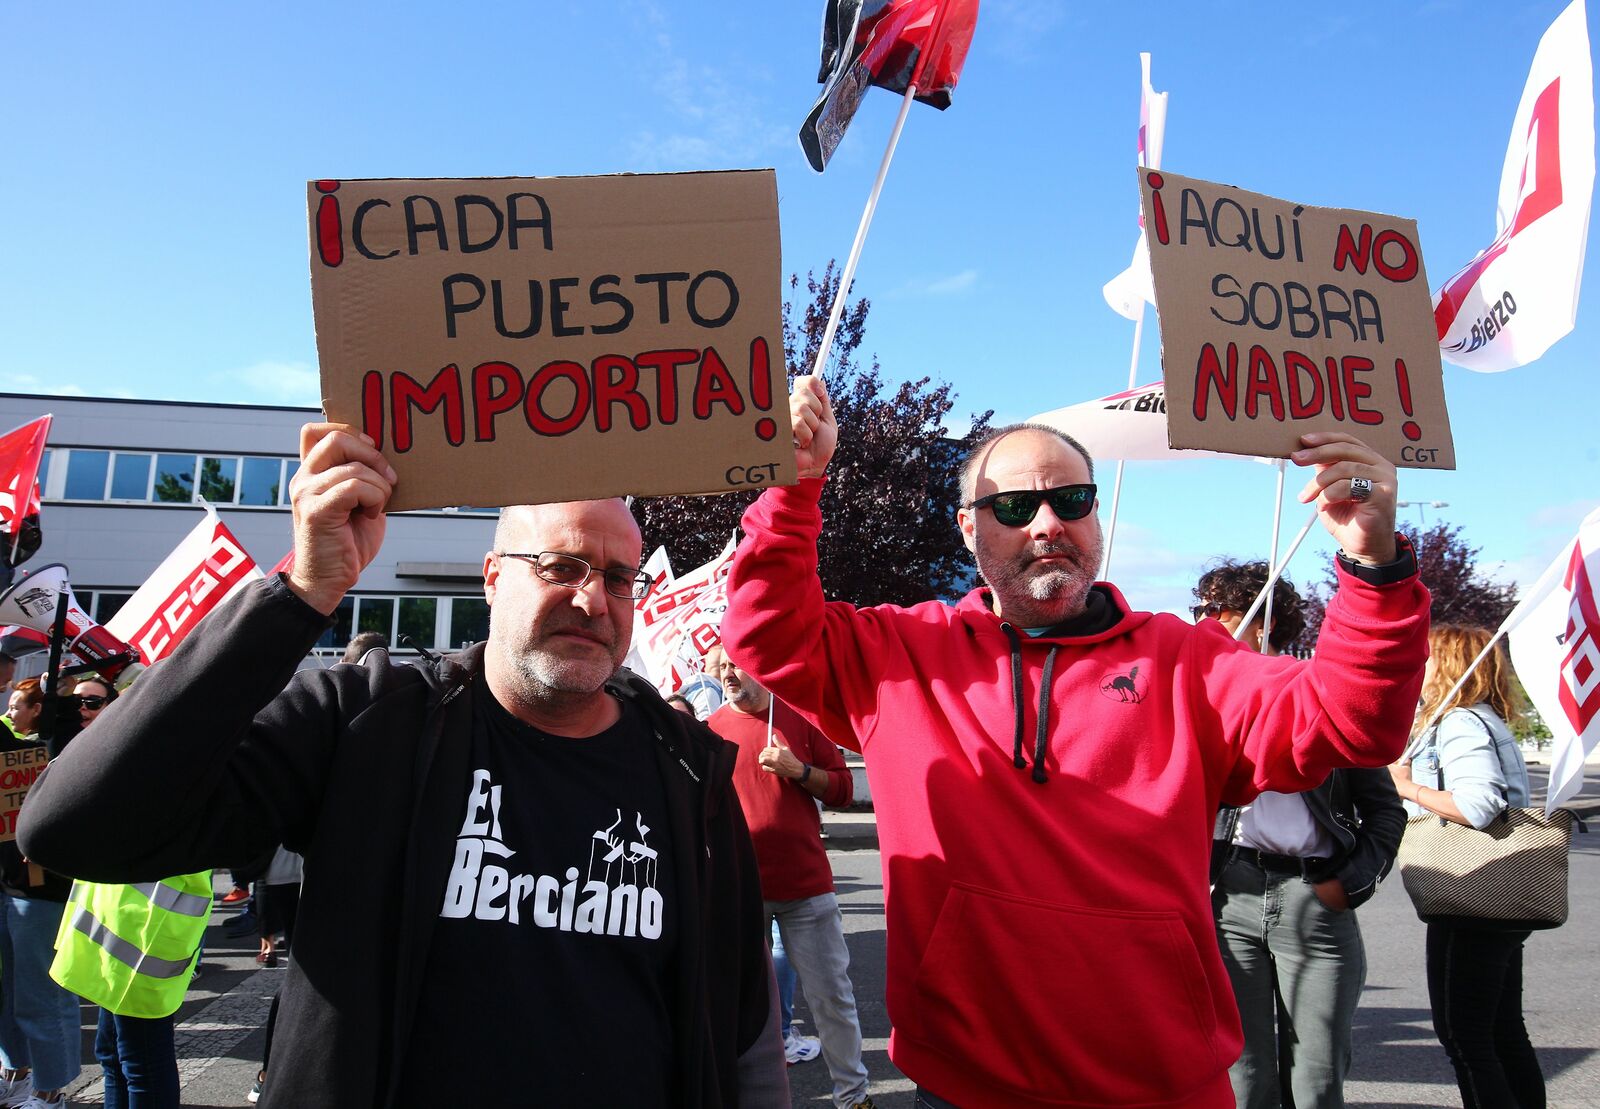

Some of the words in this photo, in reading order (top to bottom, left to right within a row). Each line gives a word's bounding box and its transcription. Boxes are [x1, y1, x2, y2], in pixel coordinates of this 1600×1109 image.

[315, 180, 554, 268] ¡CADA
[1146, 171, 1305, 262] ¡AQUÍ
[1333, 223, 1420, 283] NO
[442, 269, 740, 339] PUESTO
[1209, 272, 1385, 345] SOBRA
[1464, 291, 1517, 353] Bierzo
[361, 336, 777, 453] IMPORTA!
[724, 462, 781, 486] CGT
[1400, 445, 1440, 463] CGT
[457, 768, 504, 842] El
[438, 838, 664, 941] Berciano
